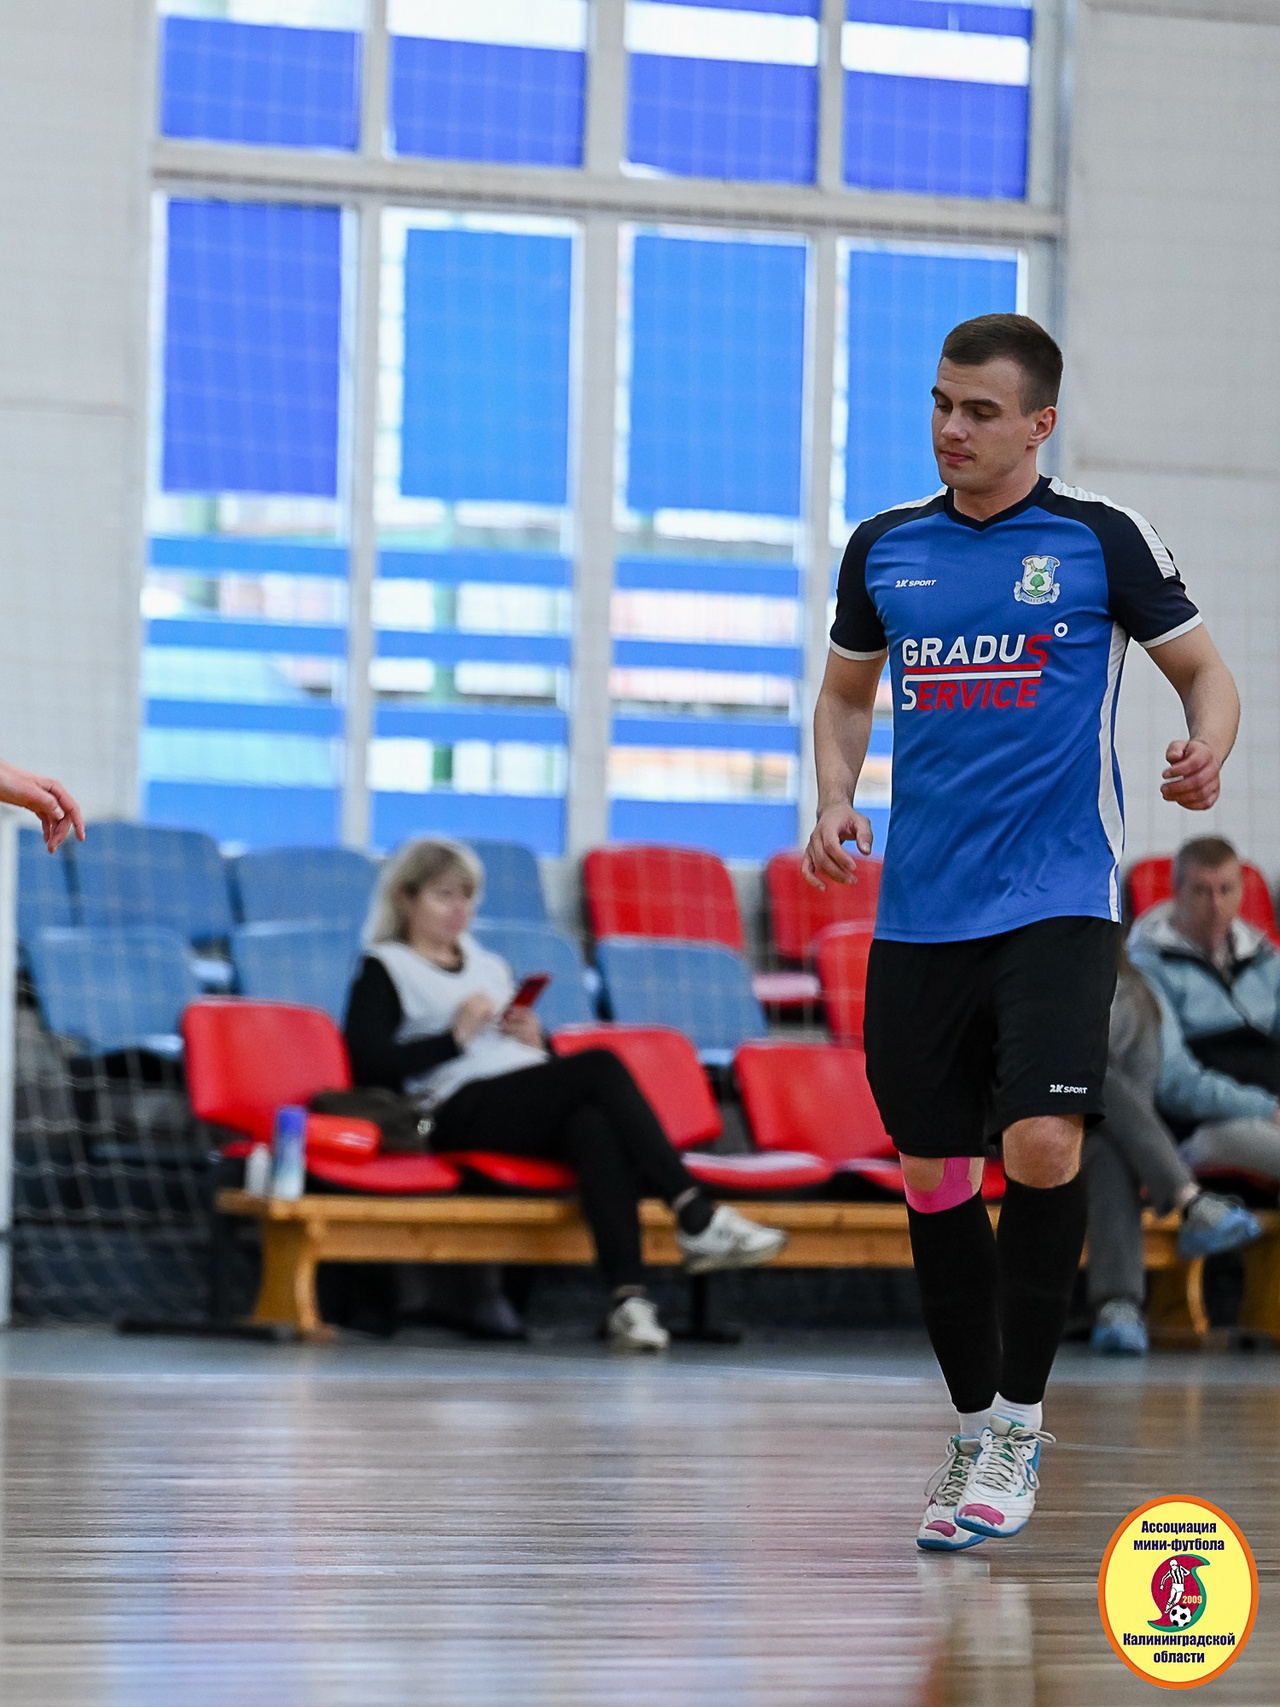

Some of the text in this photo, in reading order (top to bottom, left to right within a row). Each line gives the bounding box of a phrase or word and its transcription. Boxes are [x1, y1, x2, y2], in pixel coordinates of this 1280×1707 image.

[895, 579, 937, 588] 2K SPORT
[901, 671, 1043, 711] SERVICE
[1050, 1084, 1088, 1094] 2K SPORT
